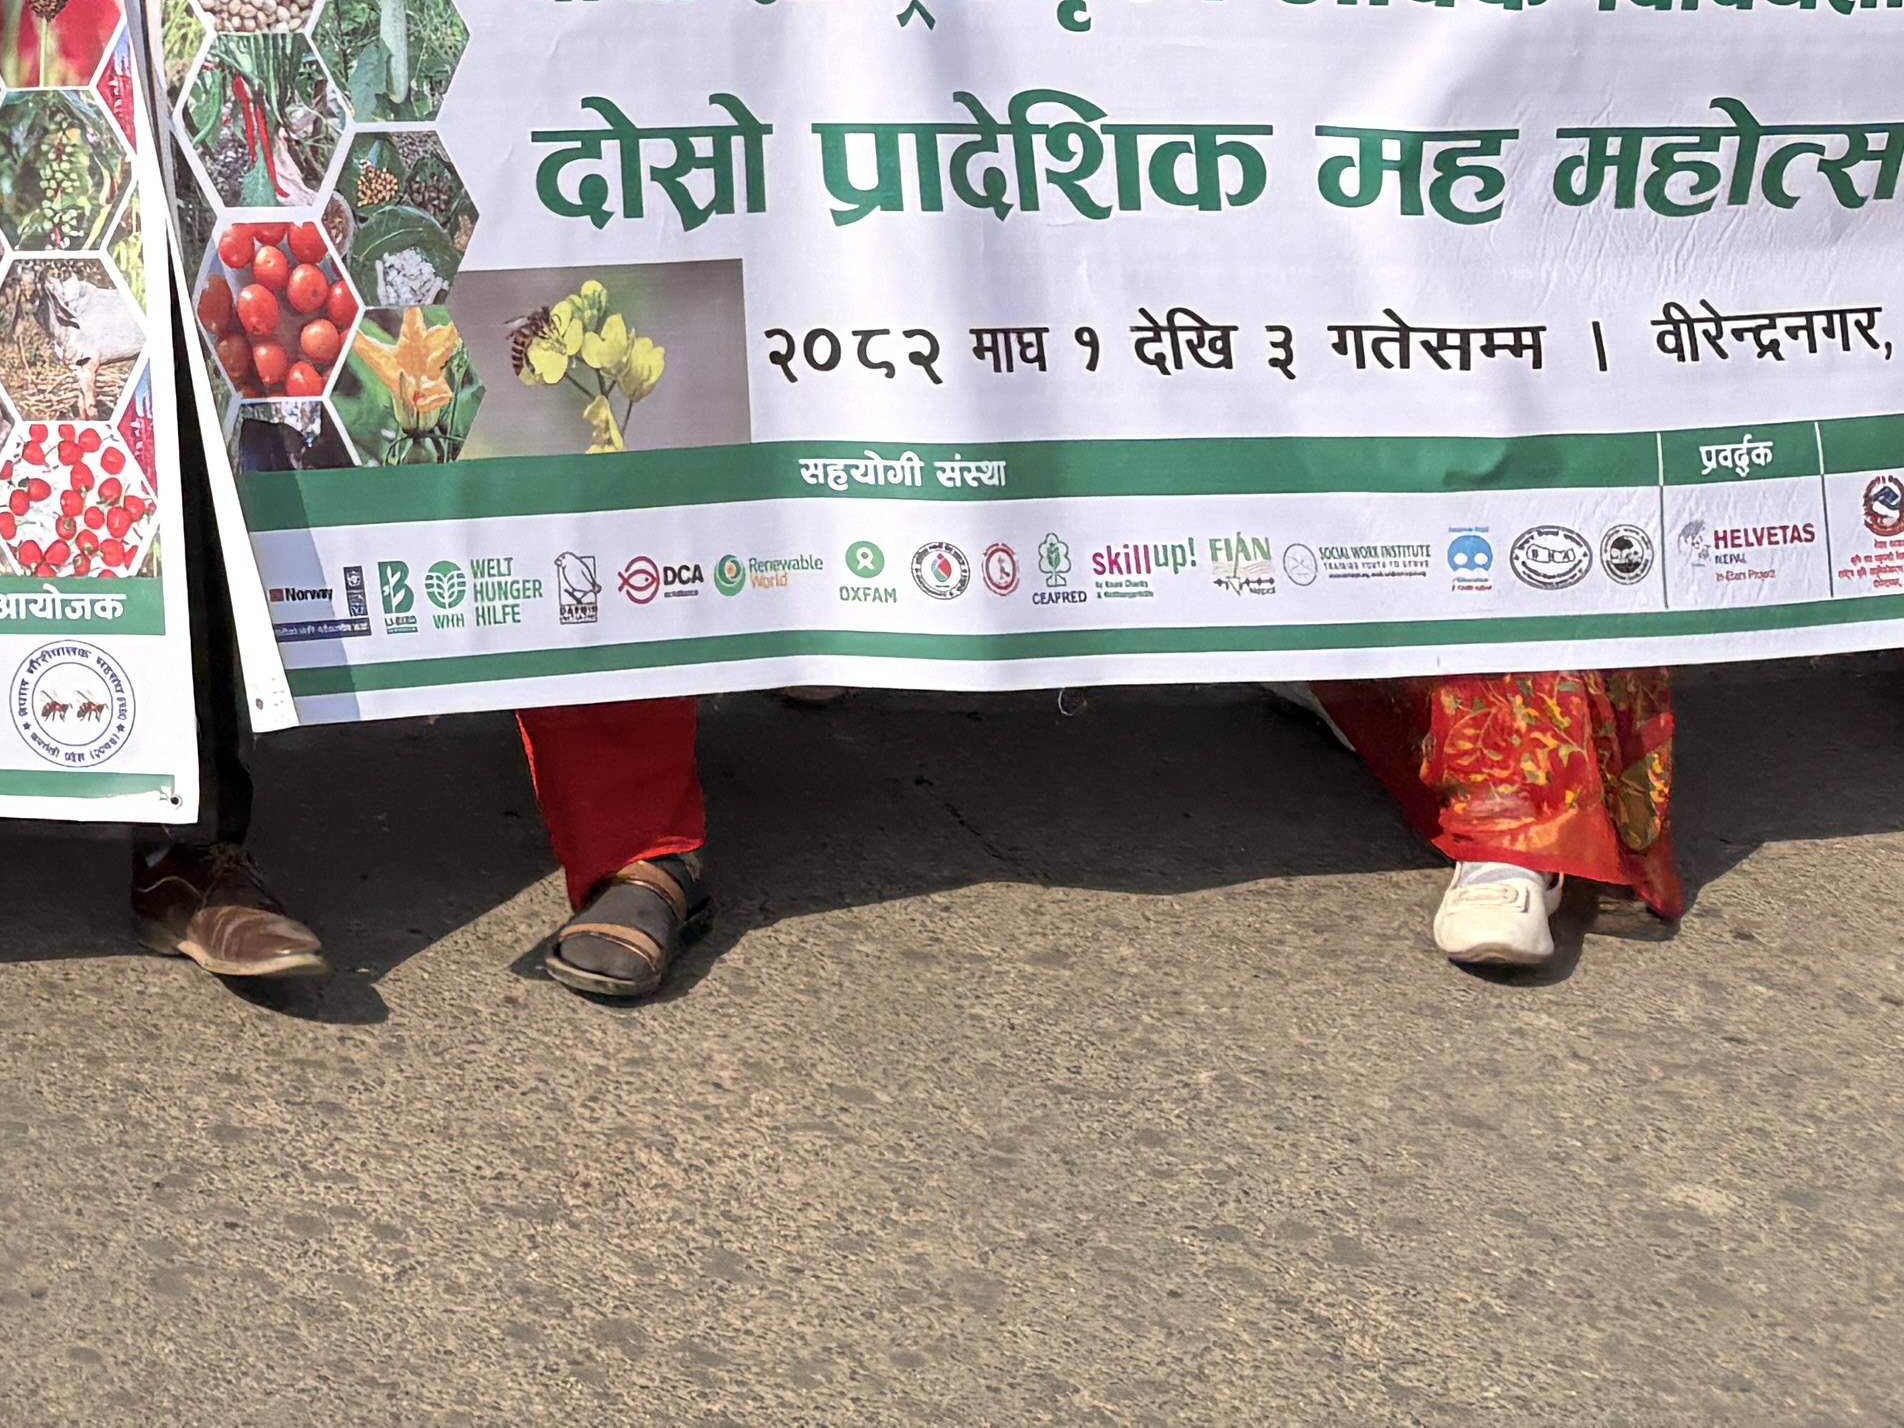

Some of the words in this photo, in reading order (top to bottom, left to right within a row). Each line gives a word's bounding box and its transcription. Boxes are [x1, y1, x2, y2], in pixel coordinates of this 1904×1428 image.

[530, 92, 774, 233] दोस्रो
[810, 88, 1274, 227] प्रादेशिक
[1314, 124, 1520, 226] मह
[1552, 96, 1904, 218] महोत्स
[763, 327, 944, 385] २०८२
[968, 326, 1050, 374] माघ
[1074, 326, 1100, 372] १
[1129, 307, 1240, 376] देखि
[1264, 324, 1297, 381] ३
[1326, 308, 1548, 372] गतेसम्म
[1650, 298, 1893, 363] वीरेन्द्रनगर,
[798, 449, 925, 491] सहयोगी
[932, 453, 1007, 488] संस्था
[1210, 532, 1273, 564] FIAN
[1713, 522, 1816, 550] HELVETAS
[470, 556, 514, 580] WELT
[662, 563, 705, 586] DCA
[748, 553, 824, 576] Renewable
[473, 576, 544, 603] HUNGER
[749, 570, 790, 590] World
[838, 585, 898, 604] OXFAM
[1031, 590, 1088, 606] CEAPRED
[432, 613, 465, 630] WHH
[475, 603, 522, 627] HILFE
